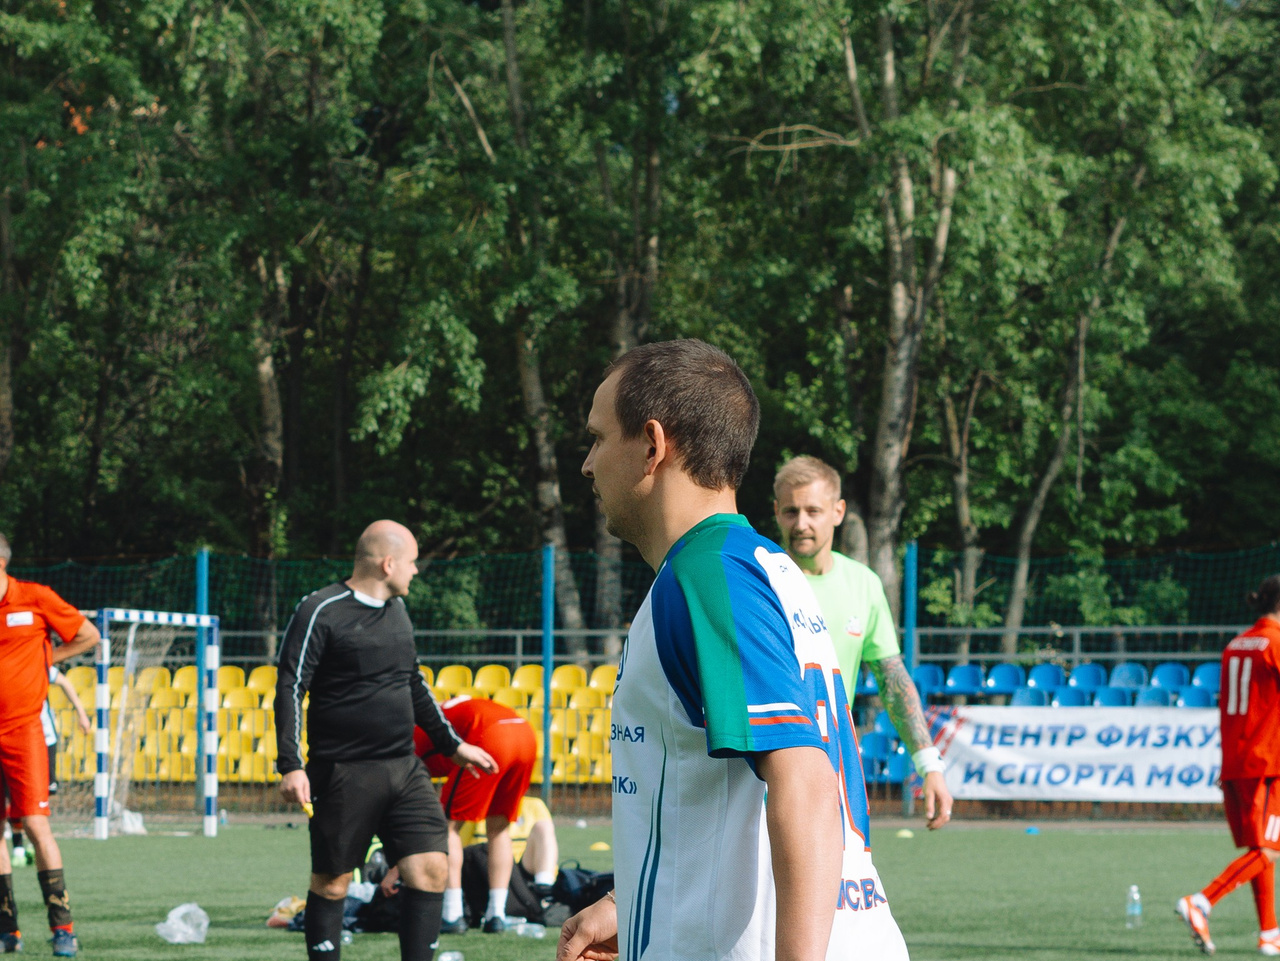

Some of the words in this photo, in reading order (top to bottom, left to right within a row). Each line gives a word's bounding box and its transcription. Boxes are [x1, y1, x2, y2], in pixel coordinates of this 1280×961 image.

[972, 724, 1087, 749] ЦЕНТР
[1096, 723, 1220, 749] ФИЗКУ
[963, 762, 987, 784] И
[996, 763, 1134, 786] СПОРТА
